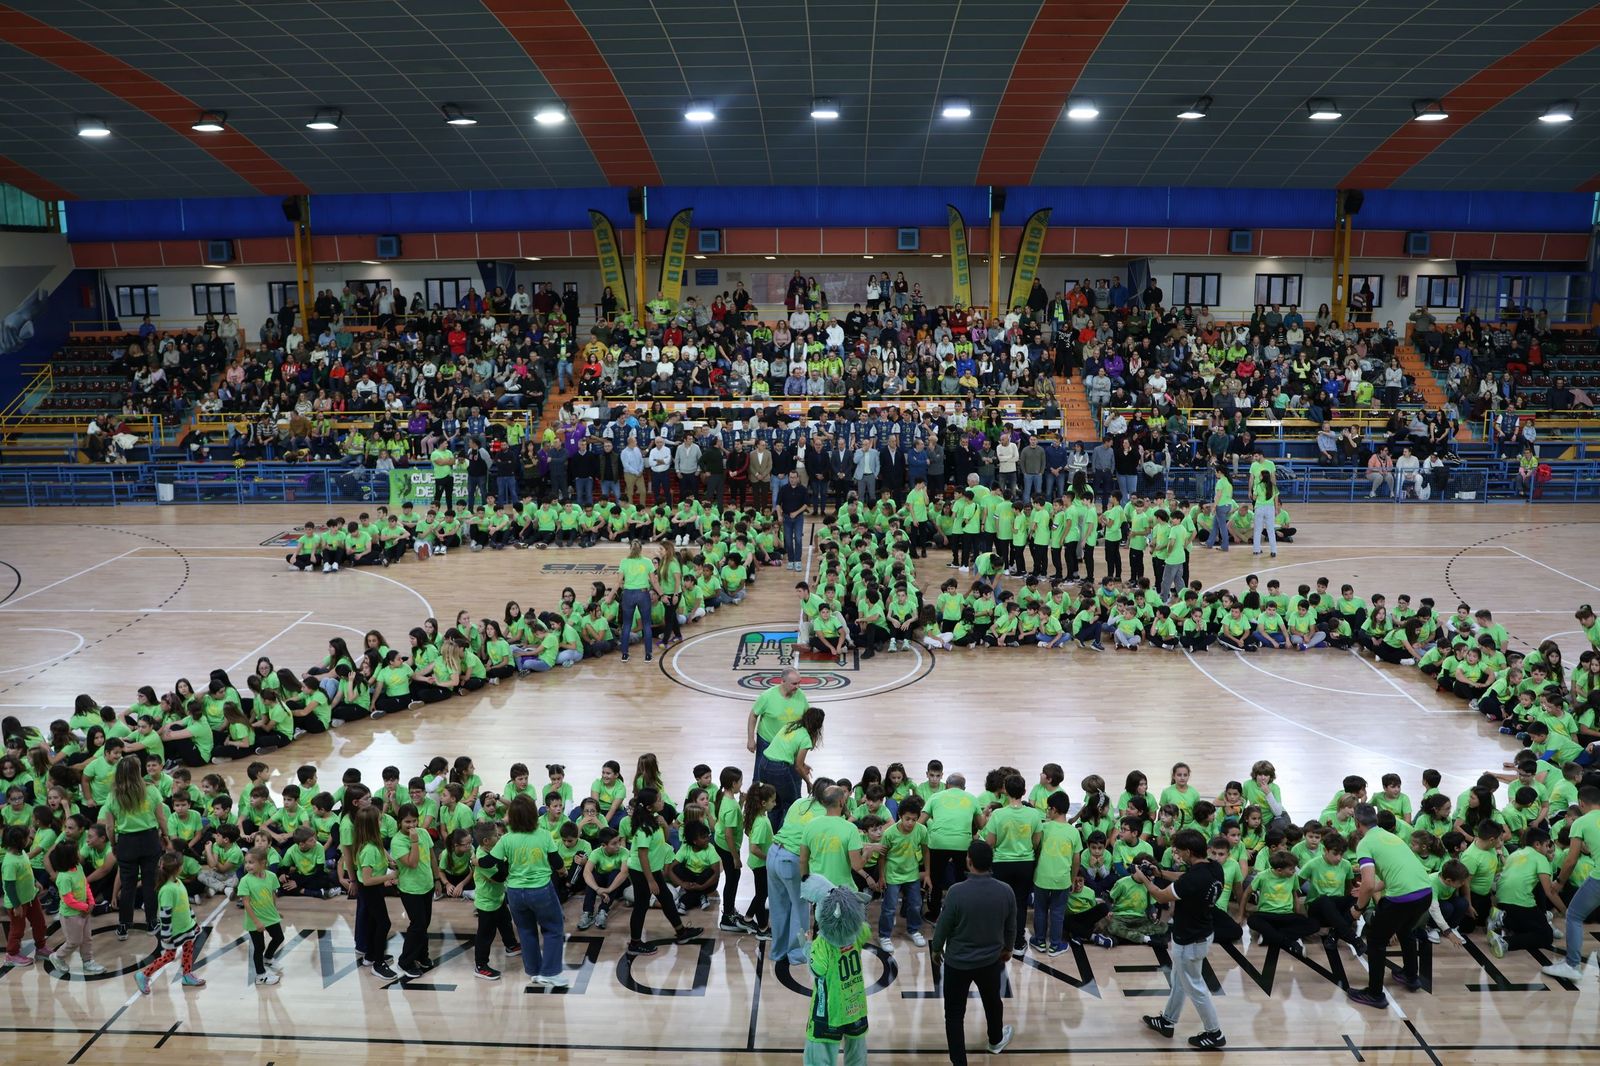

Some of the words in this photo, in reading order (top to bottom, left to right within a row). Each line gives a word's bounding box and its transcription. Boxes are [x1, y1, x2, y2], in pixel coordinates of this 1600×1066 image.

[416, 486, 434, 497] DE
[524, 936, 716, 997] DE
[838, 950, 862, 982] 00
